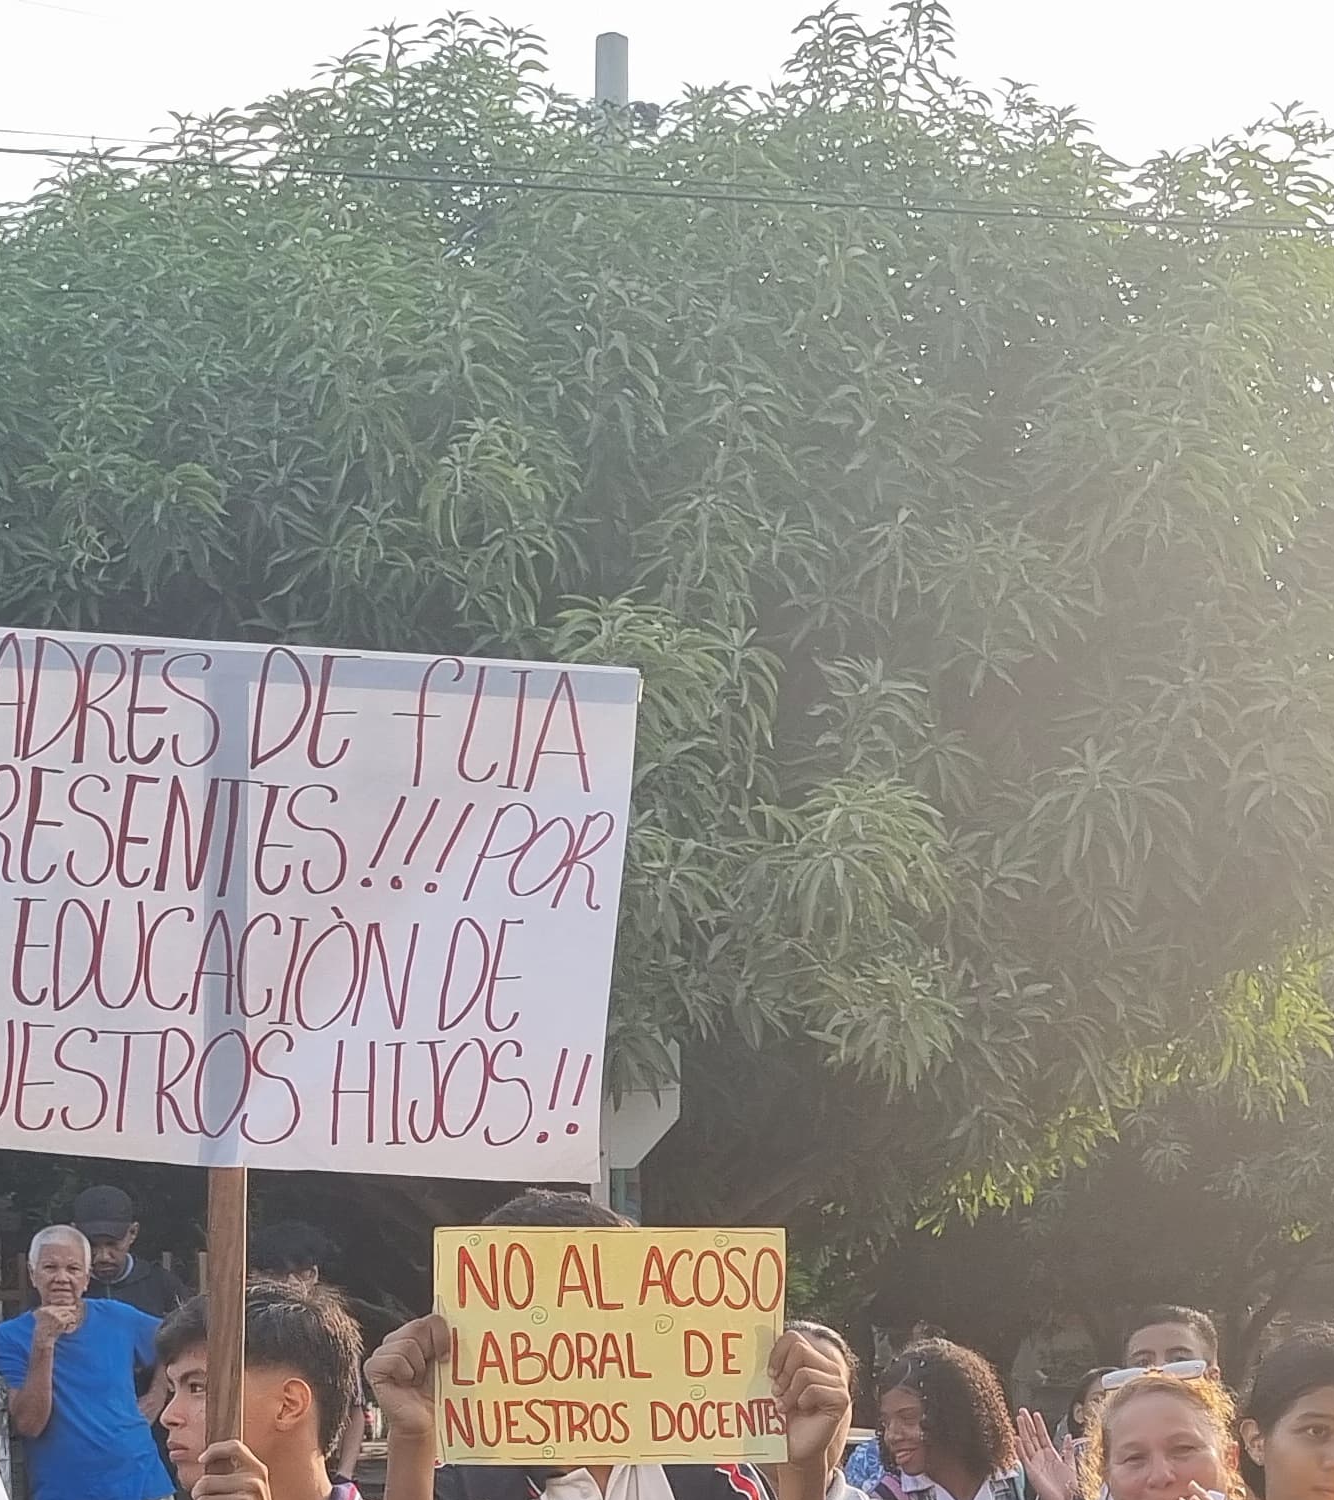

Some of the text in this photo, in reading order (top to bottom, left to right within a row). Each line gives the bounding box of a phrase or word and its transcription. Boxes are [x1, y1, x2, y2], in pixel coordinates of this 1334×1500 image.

[250, 647, 362, 770] DE
[463, 802, 615, 911] POR
[438, 917, 524, 1032] DE
[331, 1038, 592, 1147] HIJOS!!
[457, 1243, 783, 1313] NO AL ACOSO
[451, 1327, 743, 1386] LABORAL DE
[444, 1397, 630, 1448] NUESTROS
